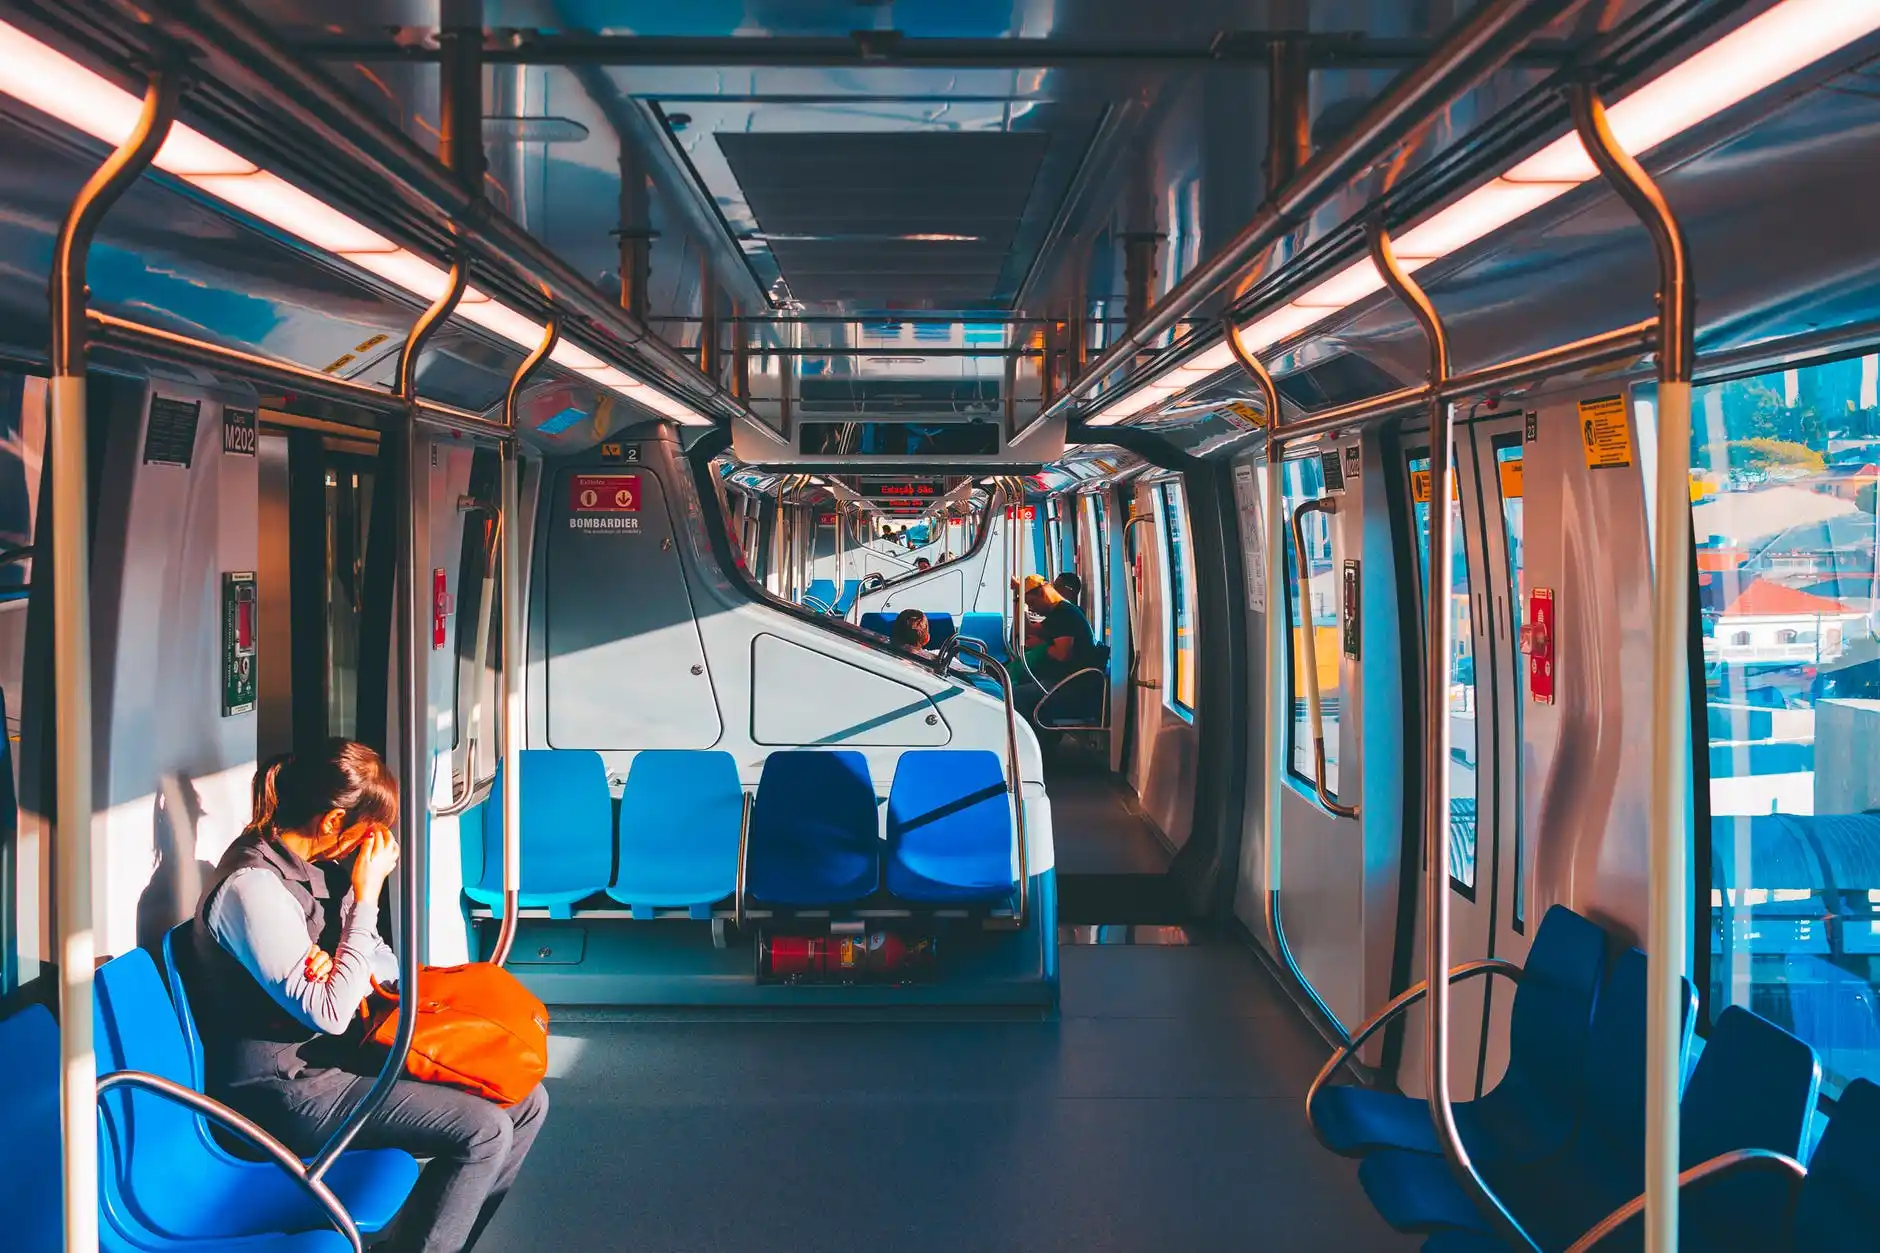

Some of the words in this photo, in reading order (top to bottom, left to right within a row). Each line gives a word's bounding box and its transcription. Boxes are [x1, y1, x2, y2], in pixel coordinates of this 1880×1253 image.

[225, 423, 254, 451] M202
[628, 449, 637, 460] 2
[569, 518, 638, 528] BOMBARDIER
